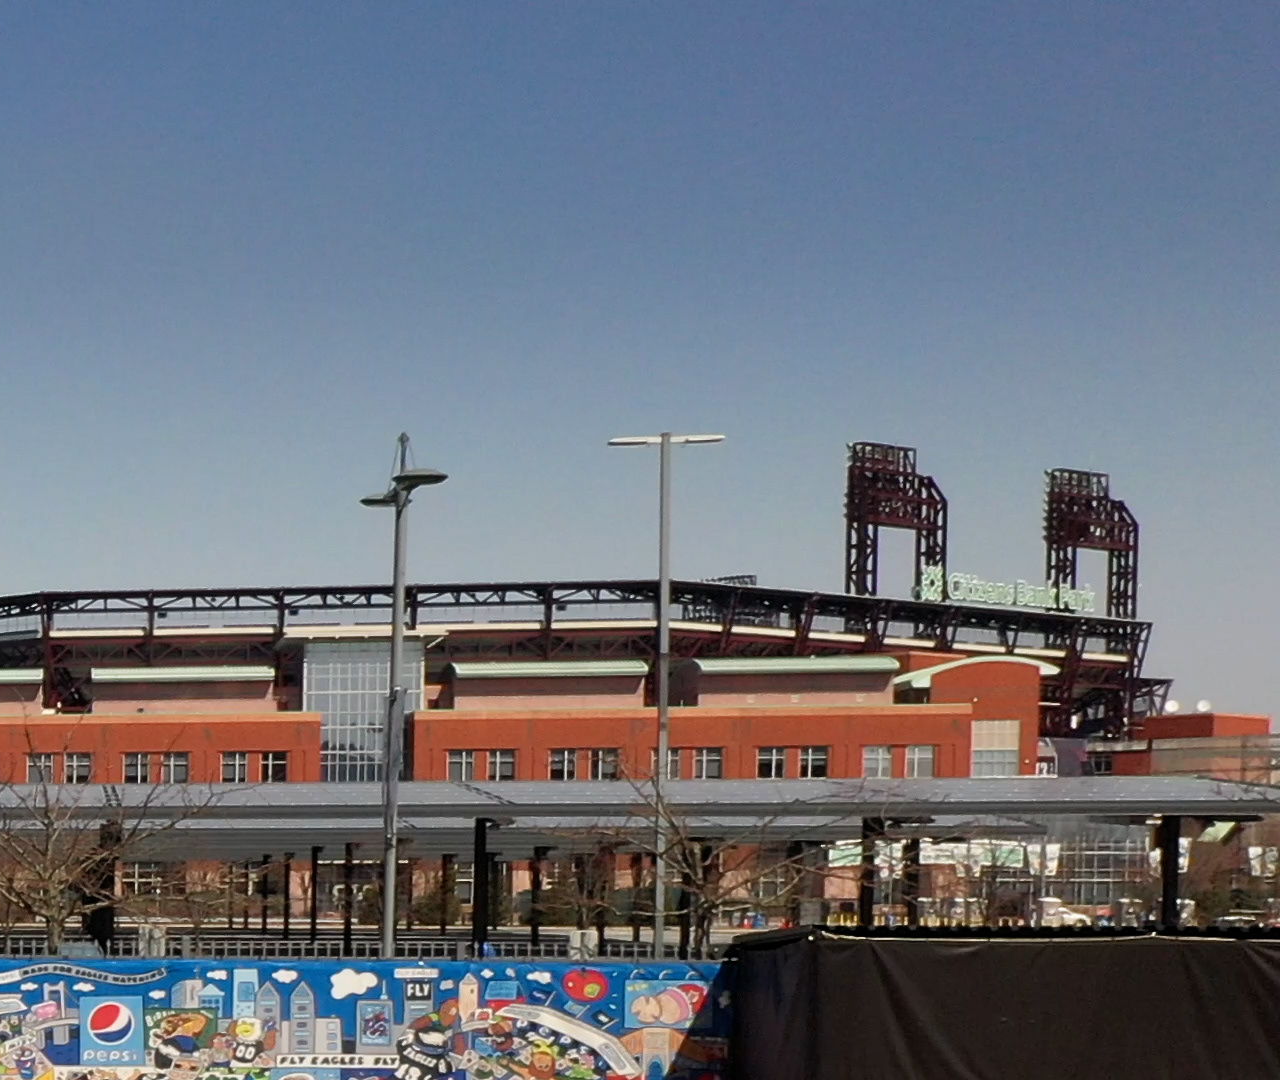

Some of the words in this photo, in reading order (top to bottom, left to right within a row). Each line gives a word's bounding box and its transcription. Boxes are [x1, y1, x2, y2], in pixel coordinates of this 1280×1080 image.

[947, 571, 1015, 606] Citizens
[1016, 579, 1057, 608] Bank
[1059, 579, 1096, 612] Park
[22, 965, 49, 976] MADE
[53, 965, 72, 975] FOR
[76, 969, 109, 981] EAGLES
[407, 983, 430, 996] FLY
[279, 1056, 306, 1066] FLY
[310, 1056, 365, 1066] EAGLES
[373, 1056, 398, 1066] FLY
